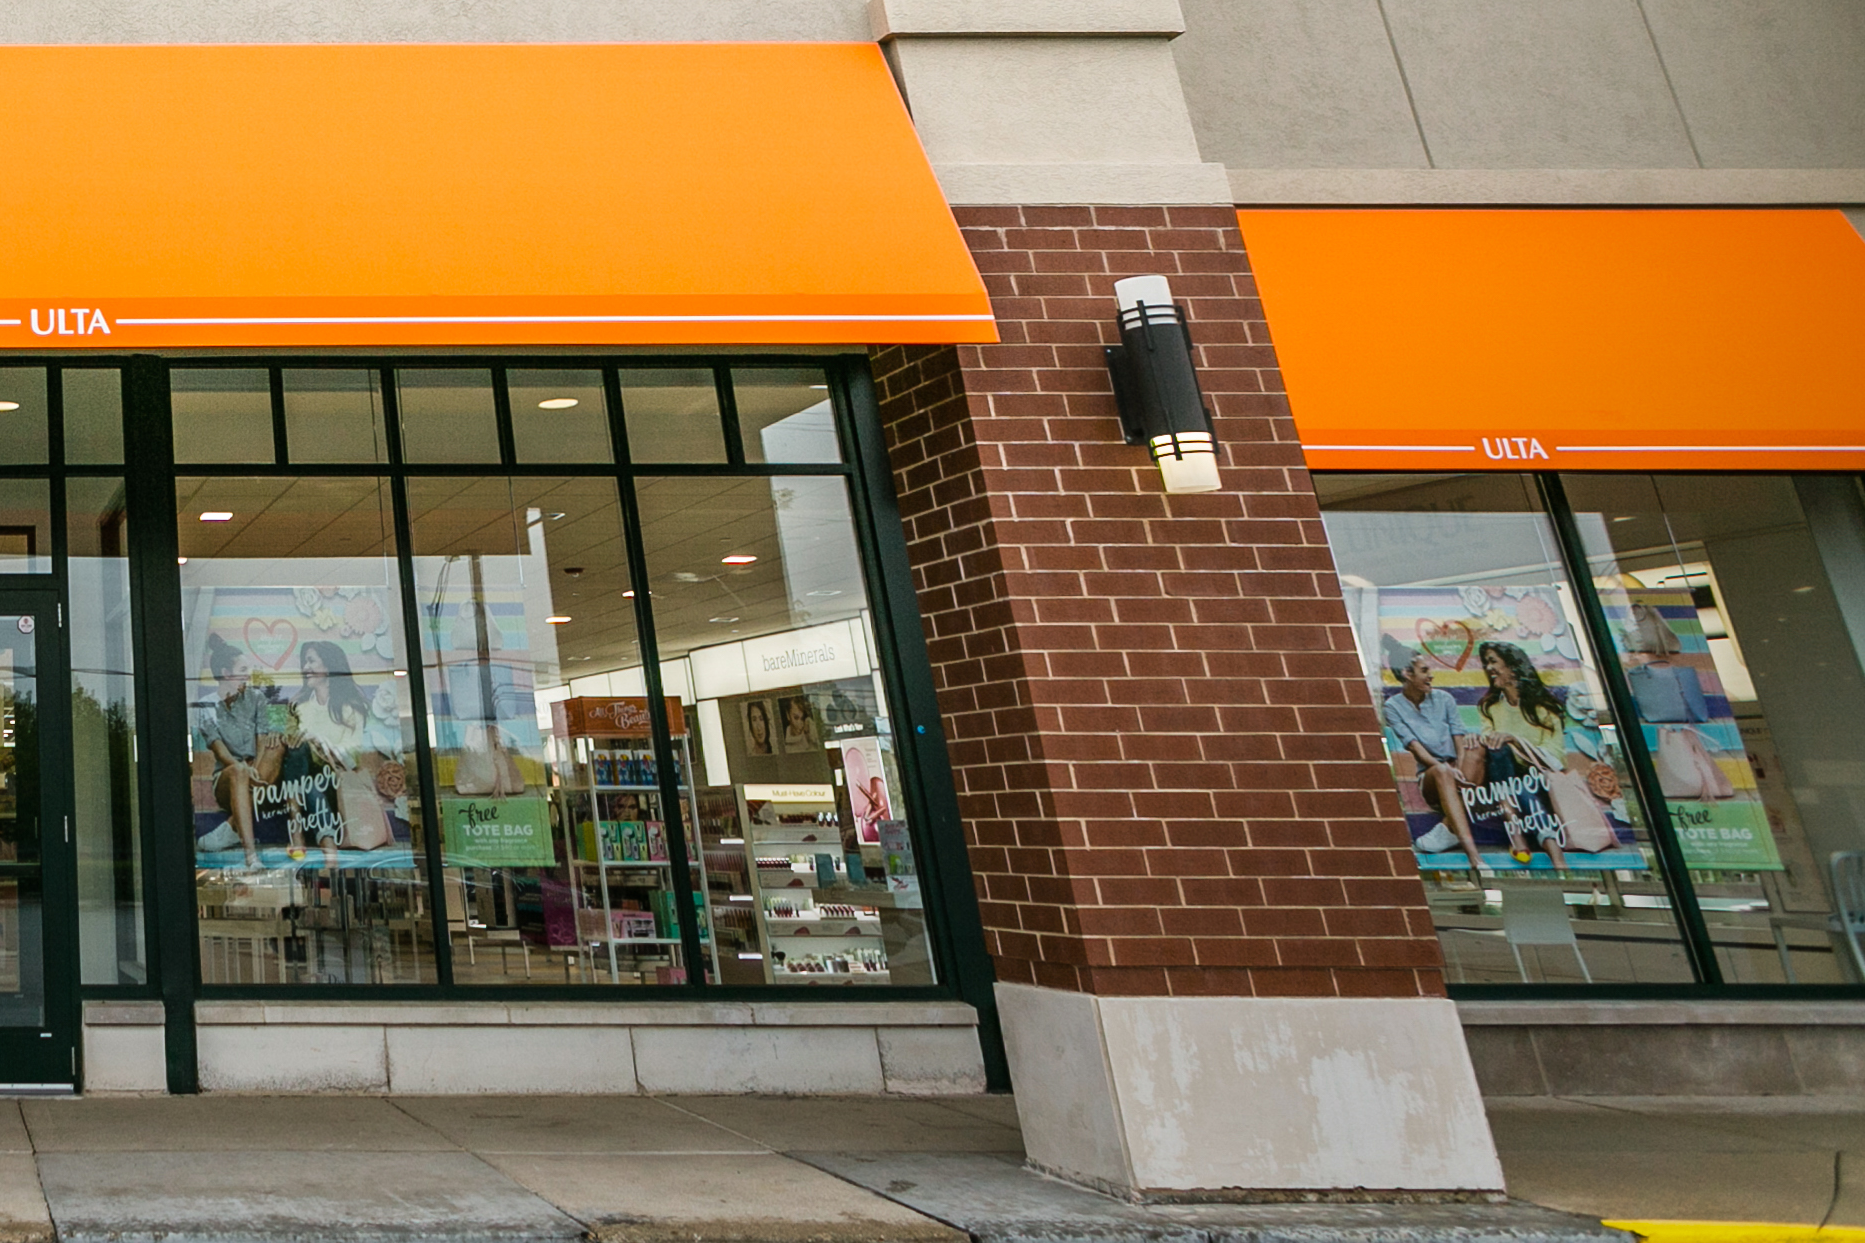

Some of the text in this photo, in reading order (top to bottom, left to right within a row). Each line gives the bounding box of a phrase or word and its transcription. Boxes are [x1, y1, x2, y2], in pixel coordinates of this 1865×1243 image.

[30, 308, 111, 336] ULTA
[1481, 437, 1550, 460] ULTA
[761, 643, 835, 672] bareMinerals
[253, 765, 341, 822] pamper
[1462, 766, 1550, 824] pamper
[287, 797, 358, 846] pretty
[459, 803, 499, 829] free
[1503, 798, 1576, 848] pretty
[1669, 805, 1713, 832] free
[463, 824, 534, 837] TOTE BAG
[1675, 827, 1753, 840] TOTE BAG
